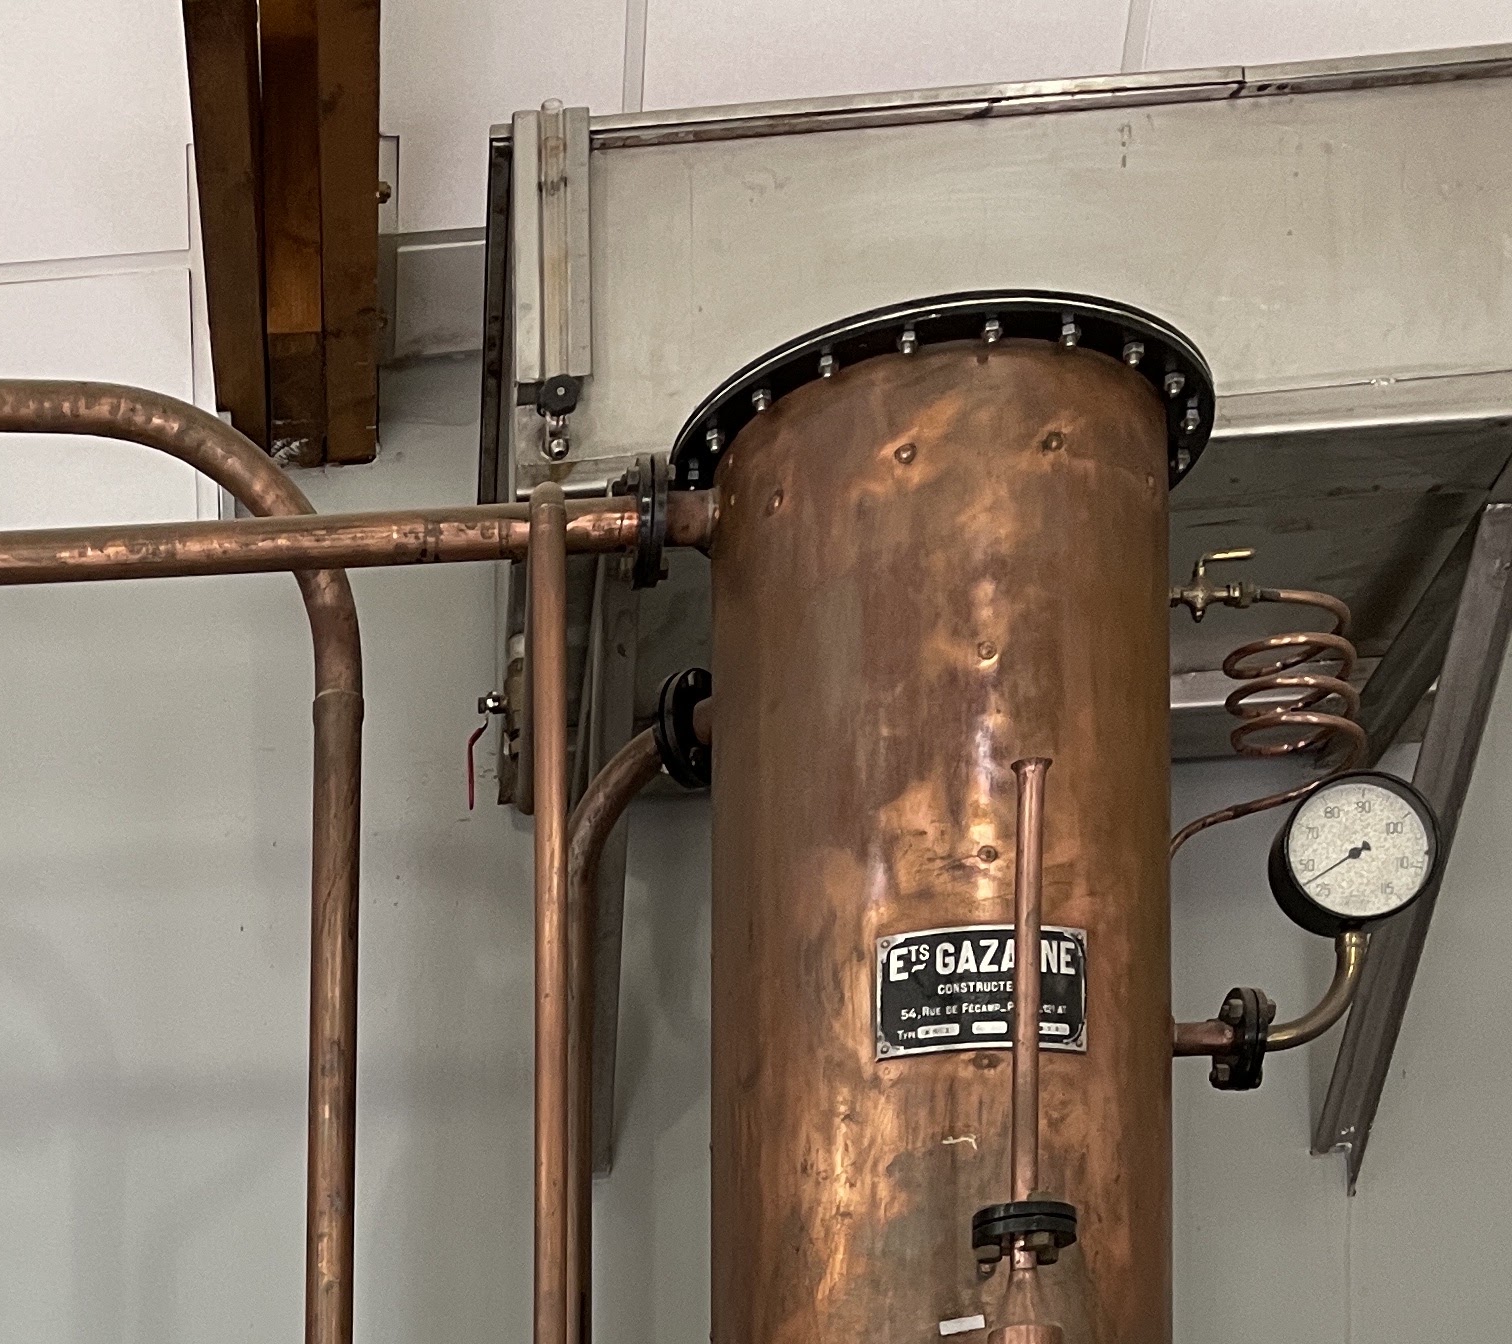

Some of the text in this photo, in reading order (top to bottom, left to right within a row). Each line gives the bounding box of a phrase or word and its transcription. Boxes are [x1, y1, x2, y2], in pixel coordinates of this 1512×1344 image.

[1386, 821, 1403, 835] 100
[1299, 858, 1315, 871] 50
[936, 938, 1076, 975] GAZANE
